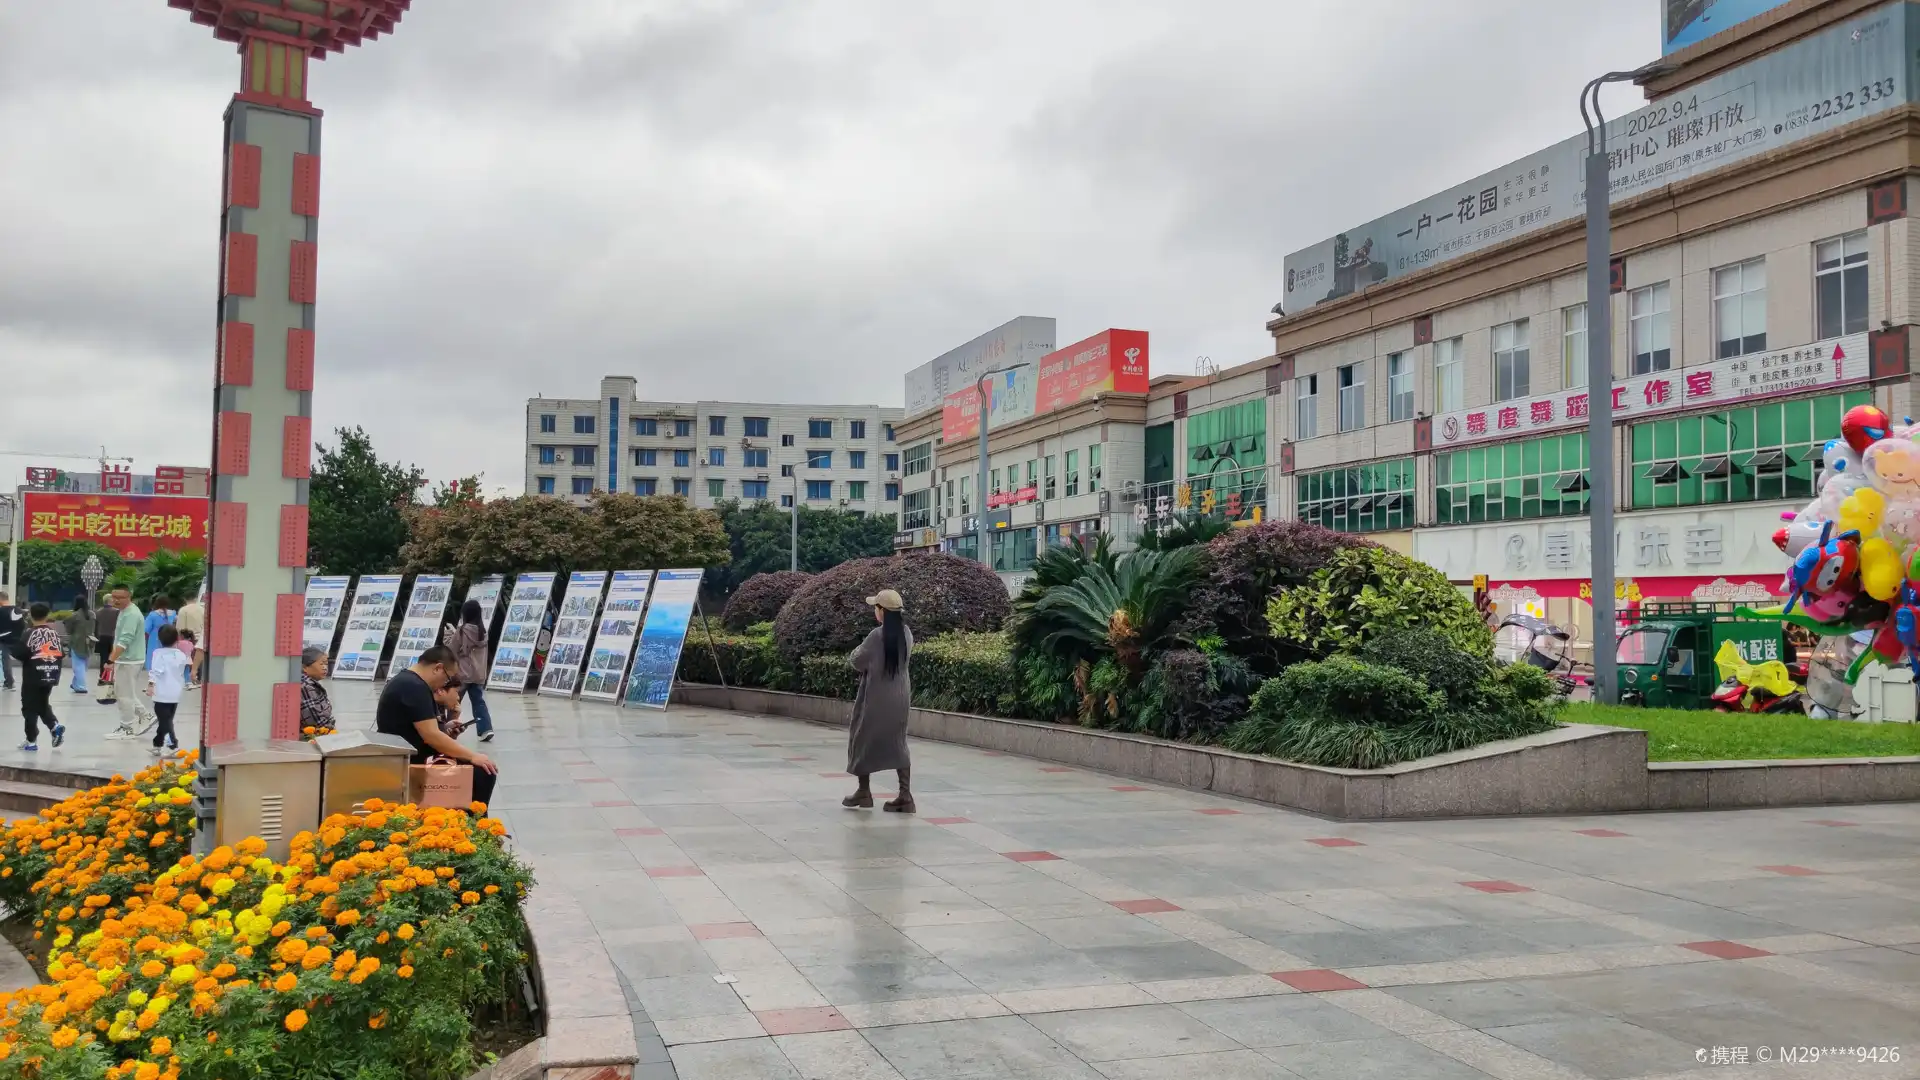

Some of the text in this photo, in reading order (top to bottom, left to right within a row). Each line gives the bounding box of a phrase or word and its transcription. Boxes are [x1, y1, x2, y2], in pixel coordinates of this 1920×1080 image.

[1628, 95, 1698, 137] 2022.9.4
[1811, 91, 1855, 122] 2232
[1860, 77, 1895, 105] 333
[1666, 102, 1744, 149] 璀璨开放
[1397, 186, 1498, 240] 一户一花园
[31, 511, 192, 539] 买中乾世纪城
